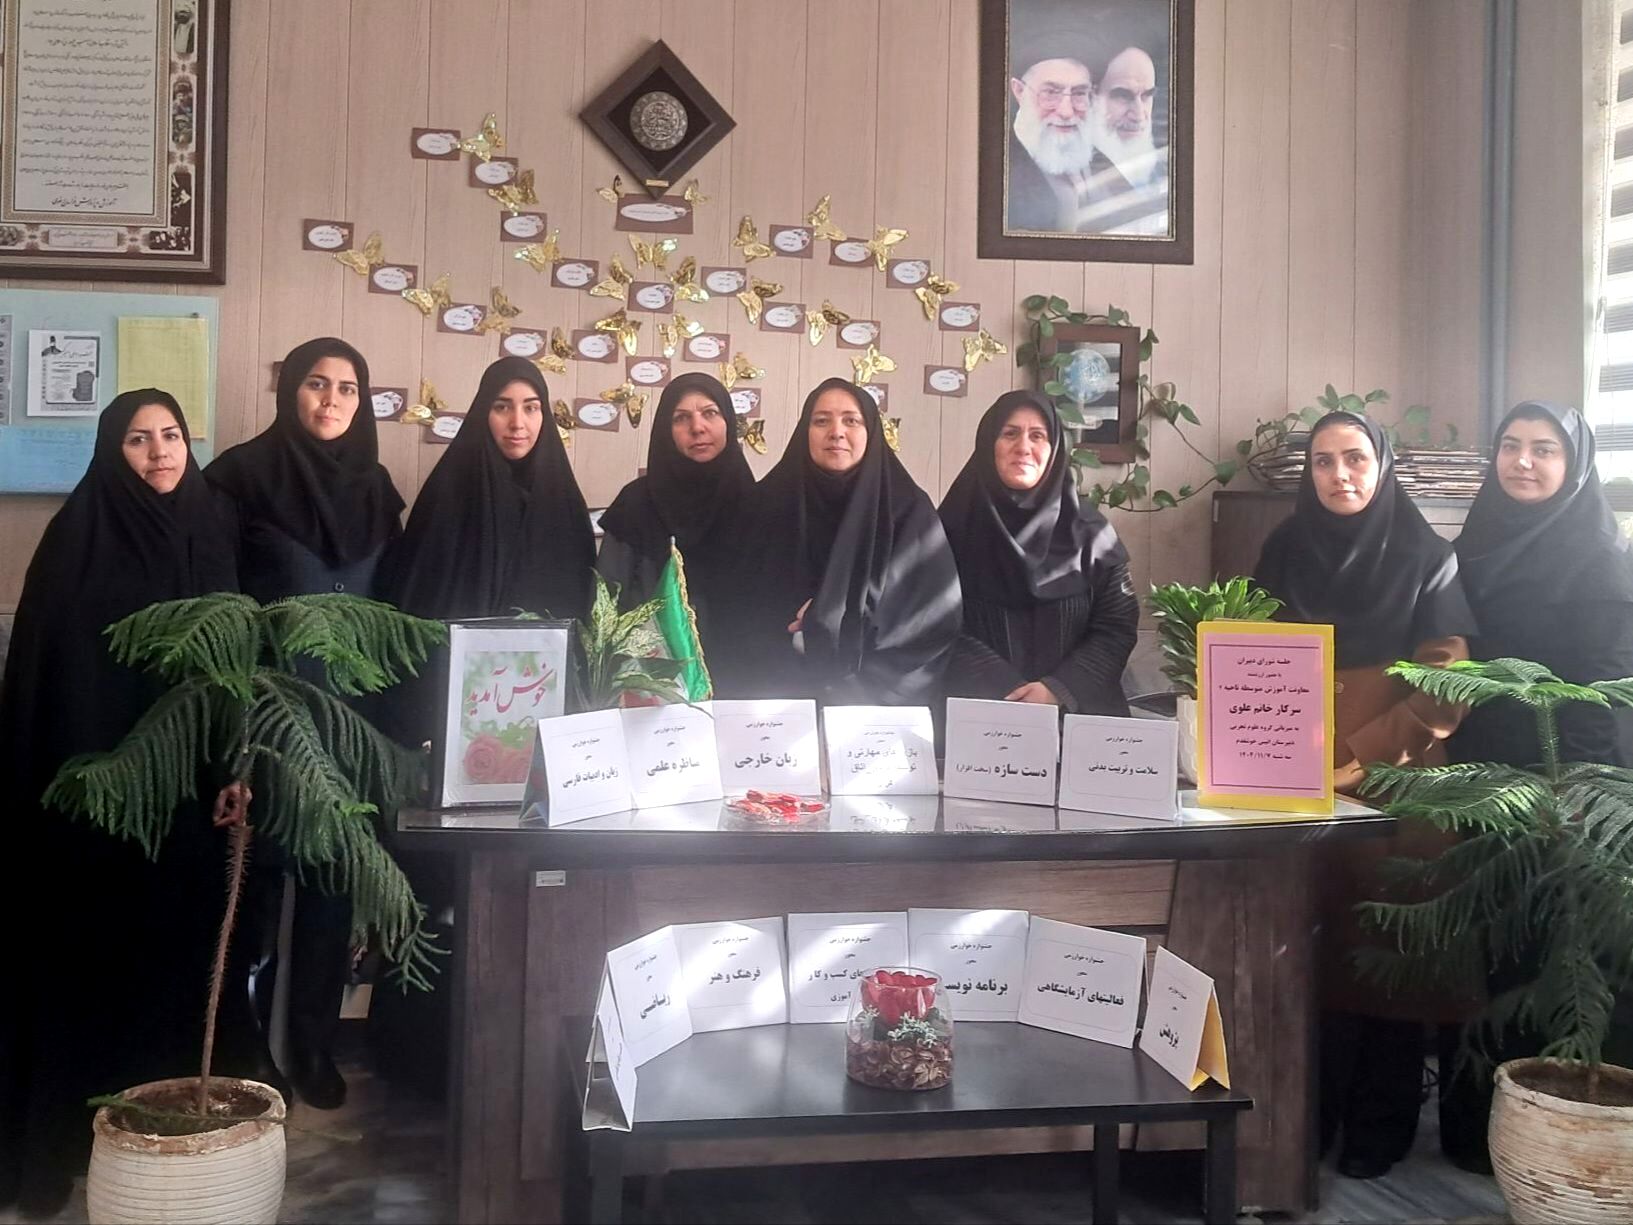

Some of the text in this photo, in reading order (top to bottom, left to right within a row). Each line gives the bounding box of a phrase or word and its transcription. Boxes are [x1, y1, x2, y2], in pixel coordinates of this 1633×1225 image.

[464, 662, 555, 717] خوش آمدید
[1229, 702, 1251, 715] علوی
[1253, 702, 1273, 714] خانم
[734, 752, 798, 769] زبان خارجی
[646, 759, 669, 777] علمی
[994, 763, 1018, 778] سازه
[1021, 766, 1048, 778] دست
[1128, 768, 1134, 776] و
[1135, 766, 1159, 776] سلامت
[708, 966, 761, 985] فرهنگ و هنر
[808, 969, 822, 981] کار
[823, 972, 829, 981] و
[829, 968, 848, 978] کسب
[943, 977, 1009, 996] برنامه نویس
[830, 990, 852, 1003] آموزی
[1037, 982, 1125, 1006] فعالیتهای آزمایشگاهی
